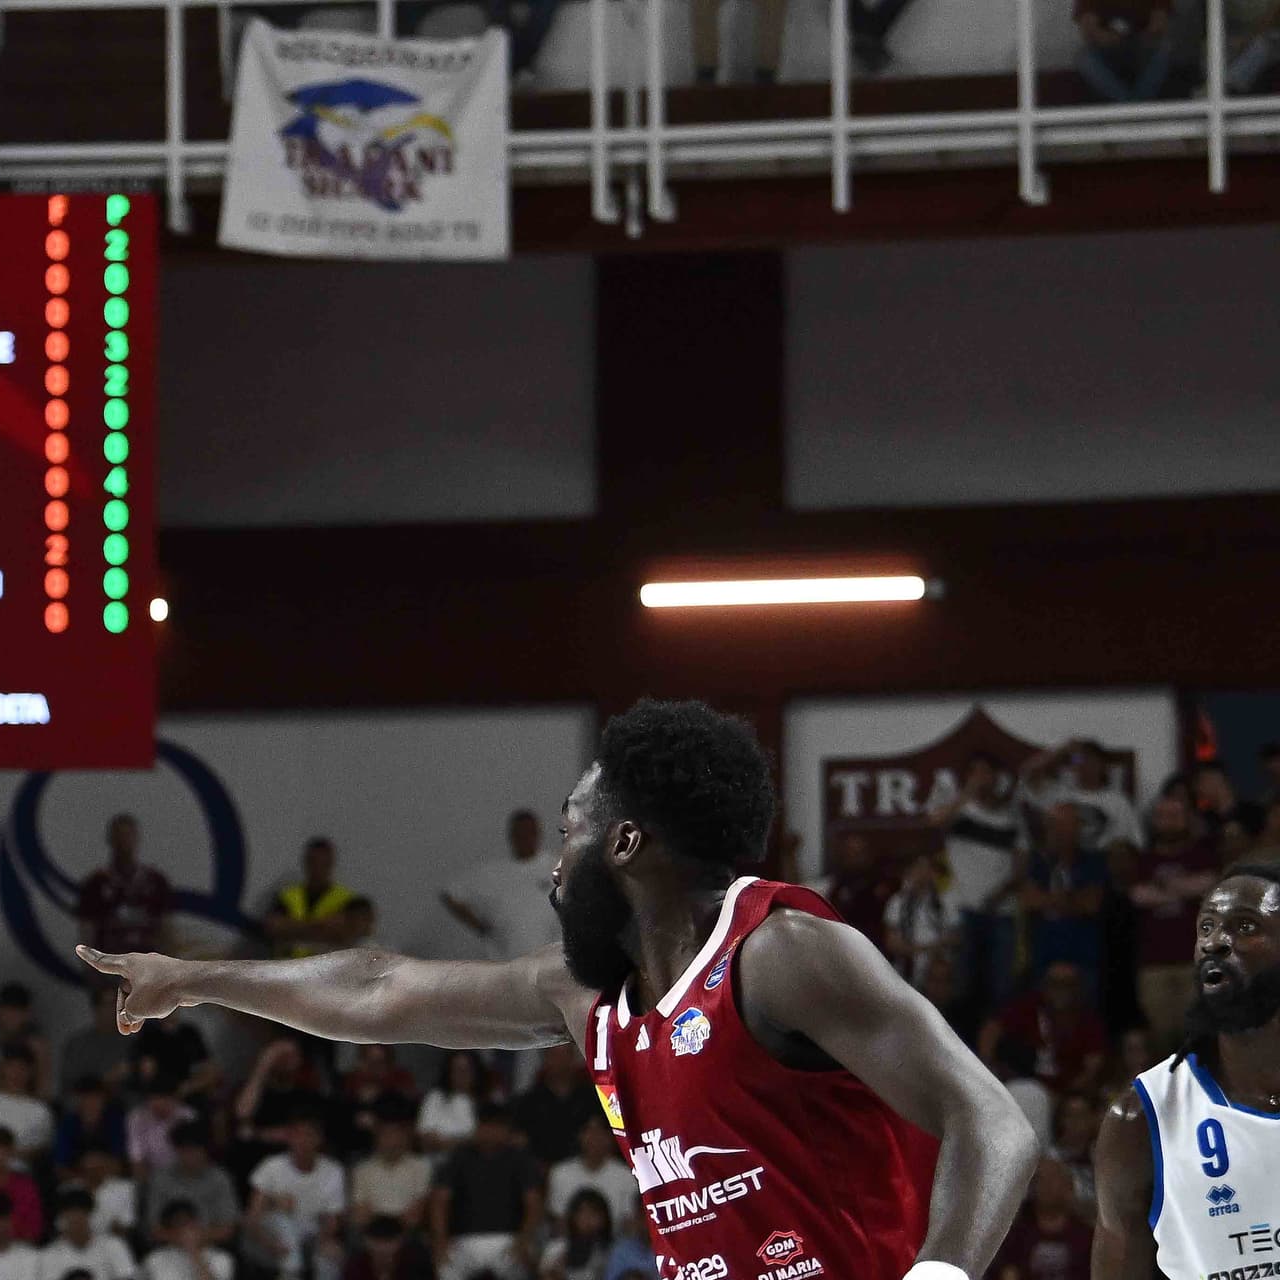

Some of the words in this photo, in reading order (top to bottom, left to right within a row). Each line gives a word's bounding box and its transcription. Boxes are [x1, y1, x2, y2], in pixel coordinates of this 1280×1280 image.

[1196, 1118, 1230, 1178] 9
[1208, 1203, 1240, 1217] errea
[765, 1238, 795, 1256] GDM
[775, 1257, 822, 1280] MARIA
